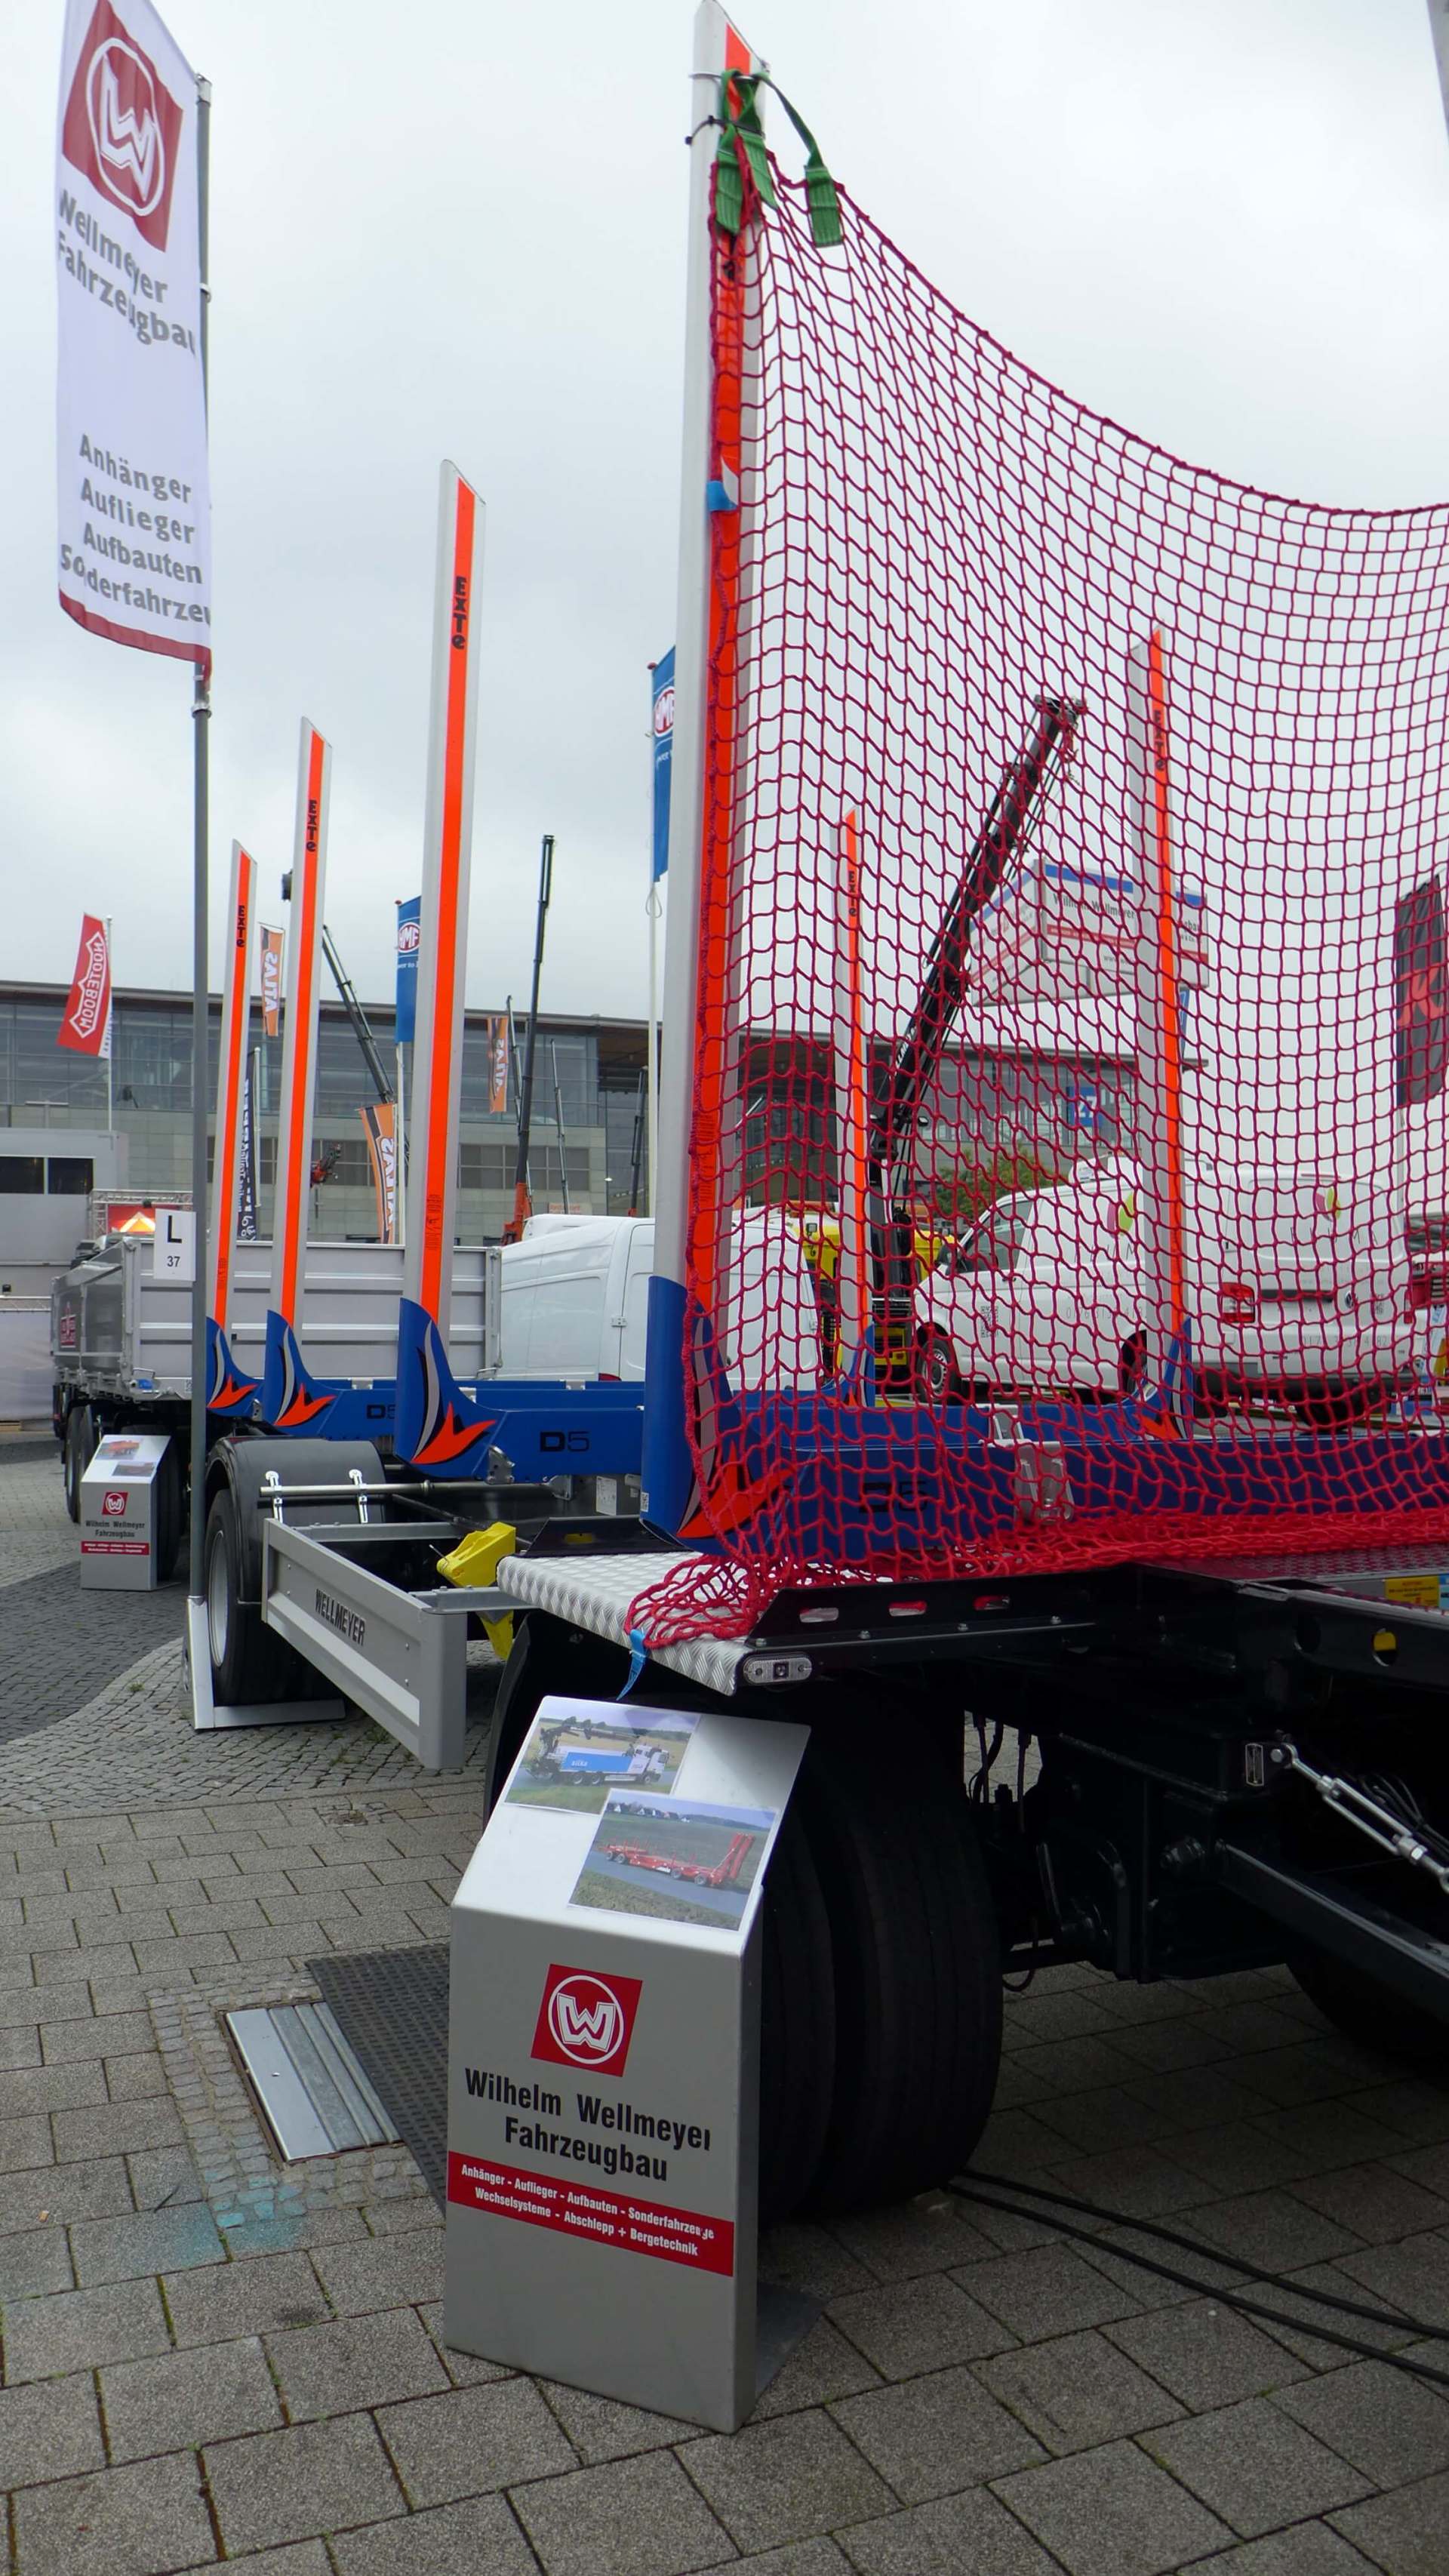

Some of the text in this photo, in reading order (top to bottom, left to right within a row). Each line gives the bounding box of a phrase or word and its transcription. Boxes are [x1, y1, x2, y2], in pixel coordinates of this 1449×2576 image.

[79, 433, 191, 503] Anhänger
[81, 478, 195, 543] Auflieger
[83, 522, 202, 584] Aufbauten
[60, 544, 211, 628] Soderfahrze
[167, 1215, 182, 1243] L
[167, 1256, 180, 1268] 37
[540, 1431, 589, 1452] D5
[315, 1589, 366, 1645] WELLMEYER
[466, 2068, 561, 2116] Wilhelm
[505, 2116, 667, 2181] Fahrzeugbau
[462, 2164, 505, 2185] Anhänger
[515, 2178, 558, 2199] Auflieger
[568, 2192, 617, 2214] Aufbauten
[475, 2187, 551, 2217] Wechselsysteme
[565, 2211, 614, 2236] Abschlepp
[630, 2228, 698, 2256] Bergetechnik
